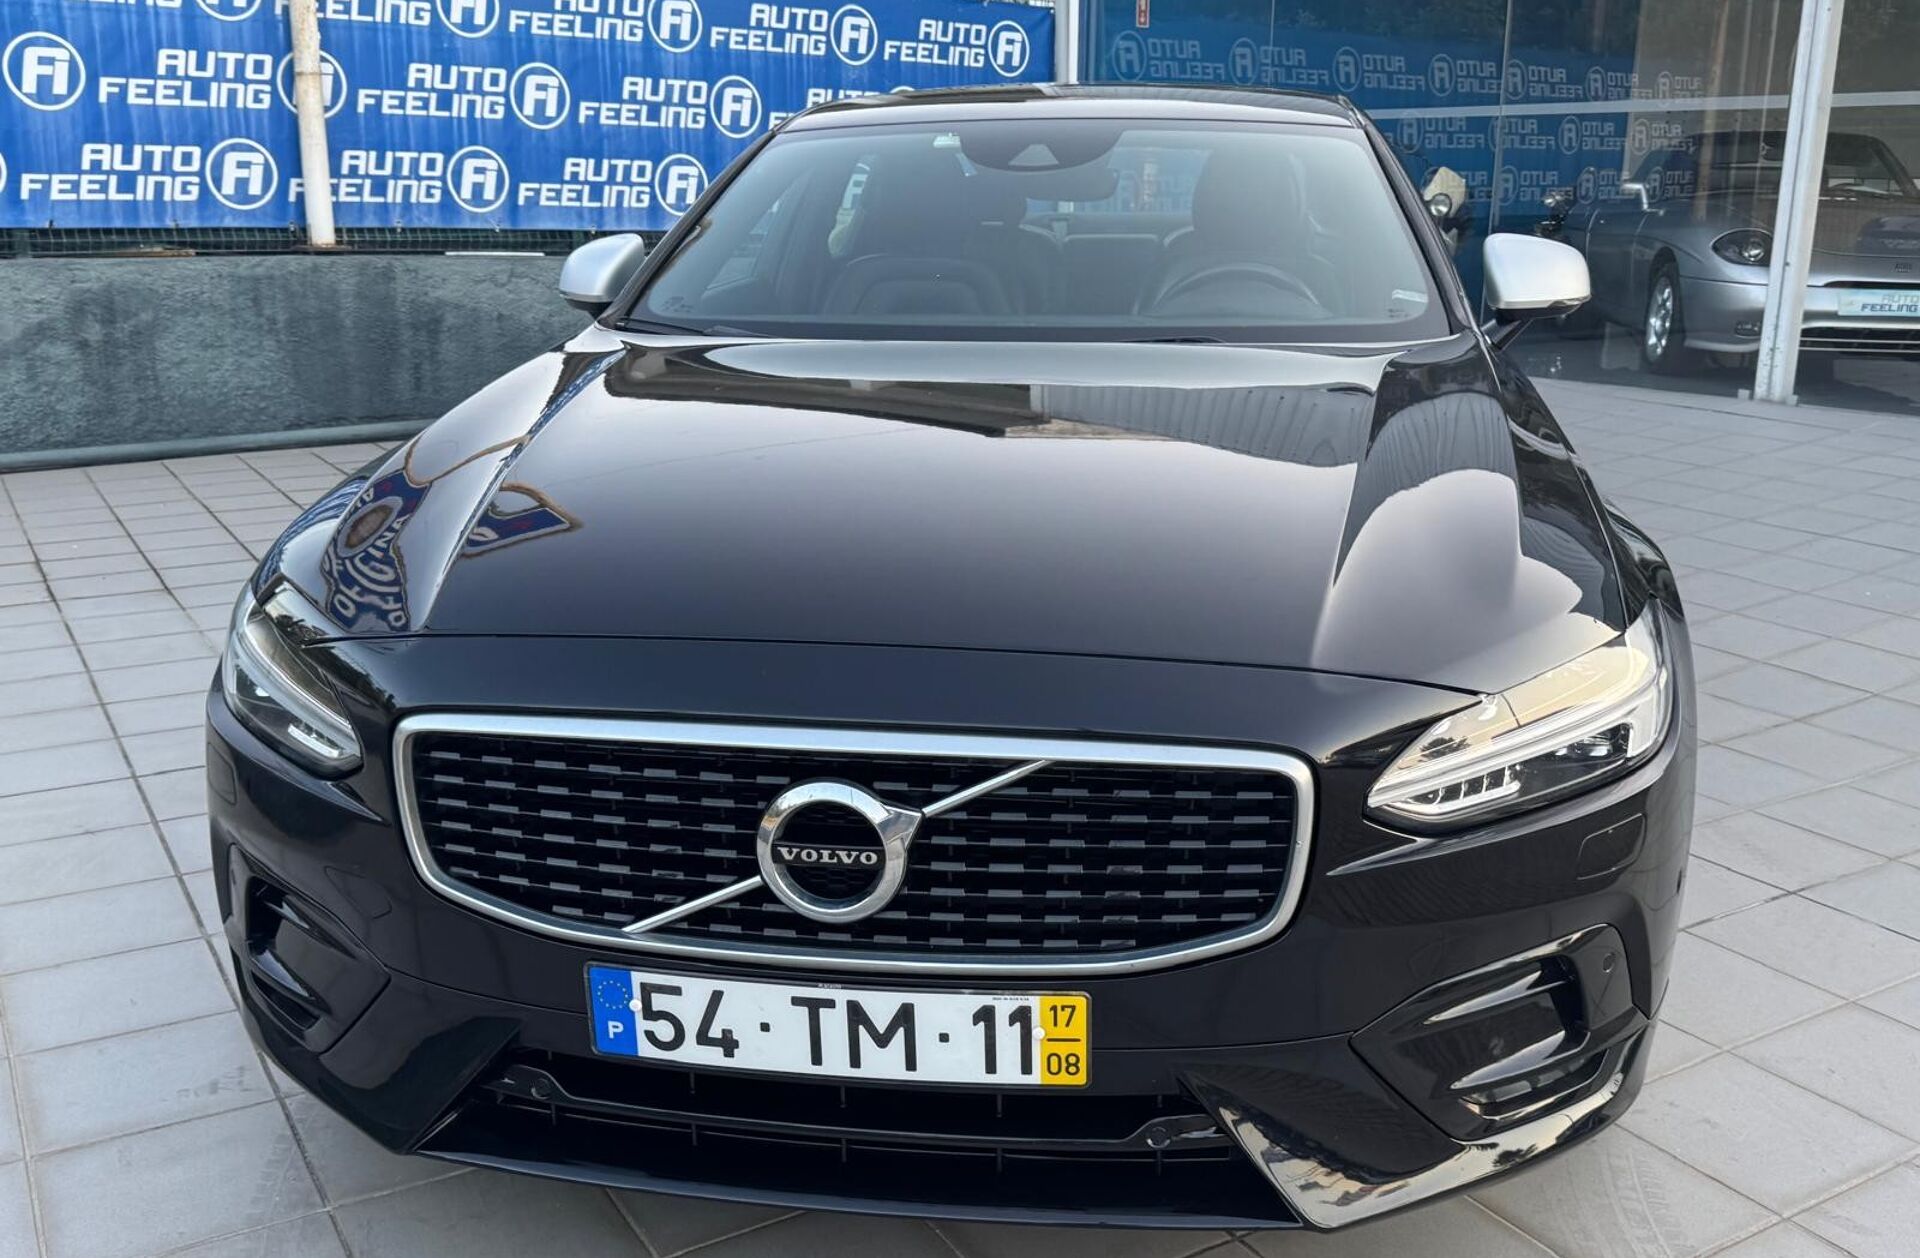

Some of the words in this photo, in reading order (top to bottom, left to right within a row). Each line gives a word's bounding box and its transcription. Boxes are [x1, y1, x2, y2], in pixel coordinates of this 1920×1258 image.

[509, 10, 644, 42] FEELING
[751, 3, 829, 32] AUTO
[709, 26, 826, 56] FEELING
[918, 19, 986, 46] AUTO
[157, 48, 273, 81] AUTO
[883, 40, 985, 68] FEELING
[408, 63, 507, 92] AUTO
[622, 76, 708, 105] AUTO
[99, 76, 272, 109] FEELING
[357, 88, 506, 120] FEELING
[578, 101, 706, 129] FEELING
[81, 143, 201, 172] AUTO
[341, 150, 444, 177] AUTO
[564, 157, 653, 184] AUTO
[20, 173, 201, 202] FEELING
[518, 182, 650, 208] FEELING
[777, 847, 878, 865] VOLVO
[607, 1020, 624, 1039] P
[1049, 1004, 1077, 1028] 17
[1046, 1052, 1081, 1076] 08
